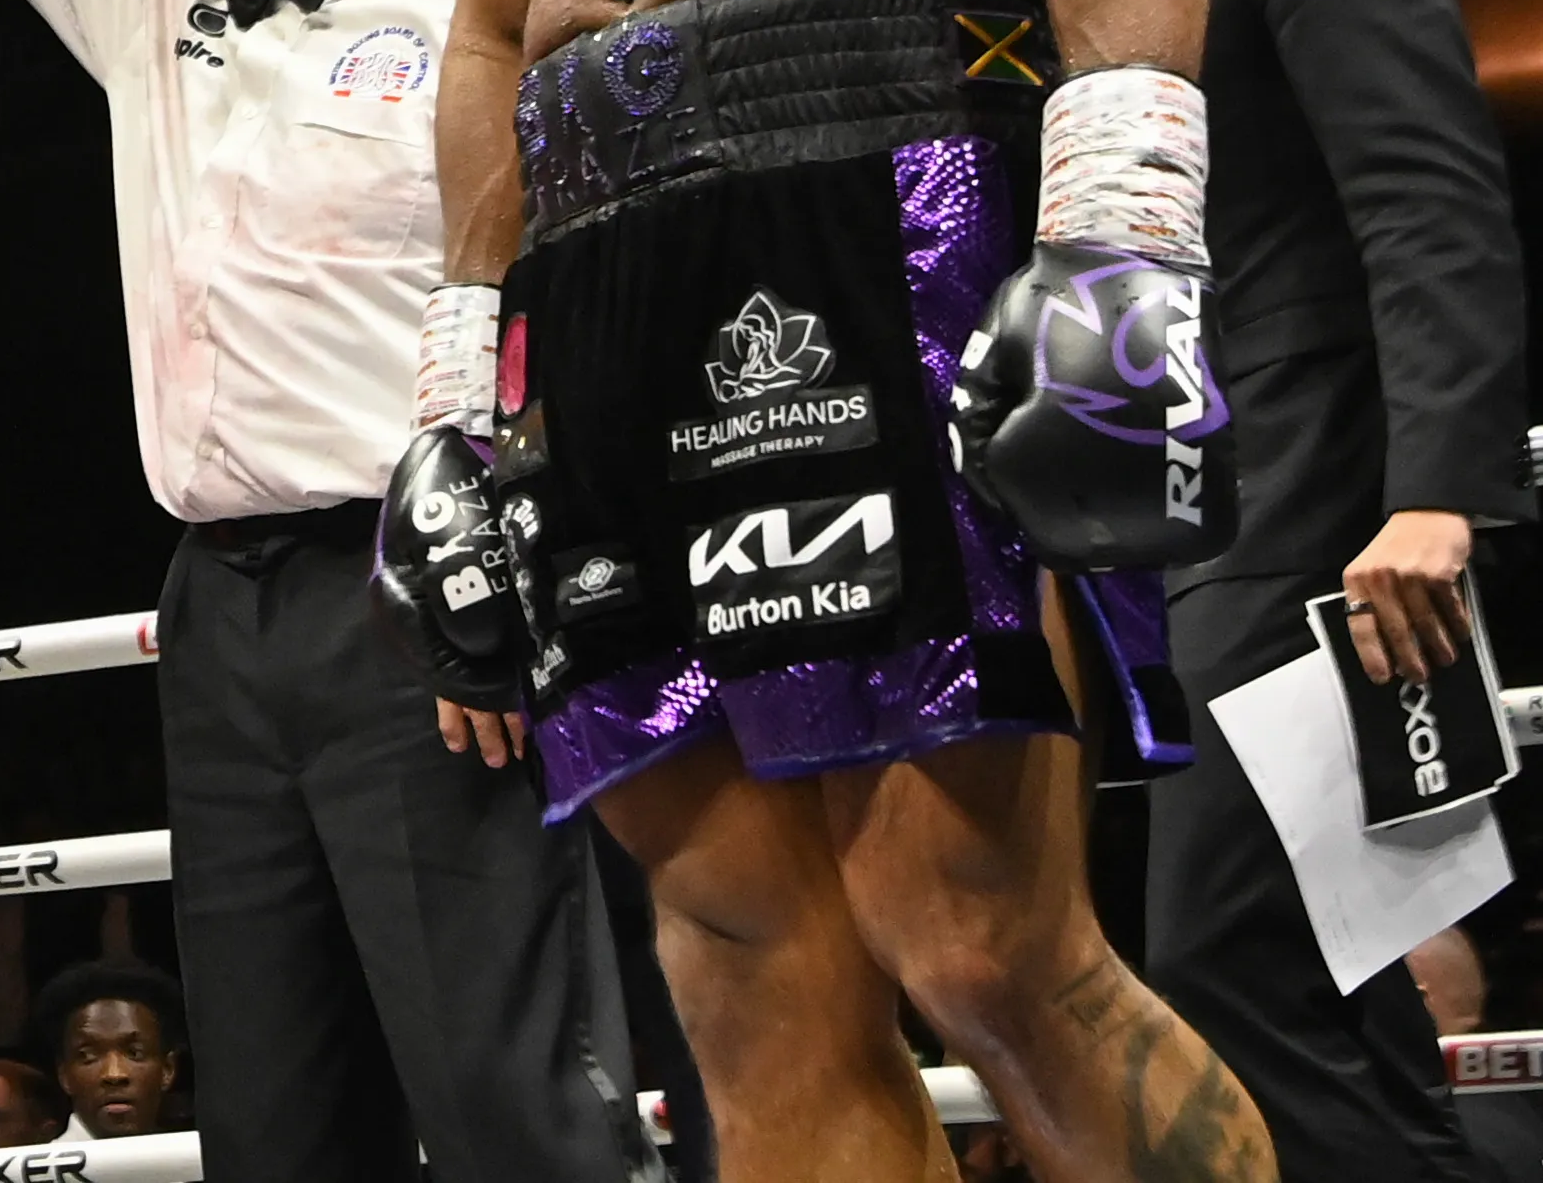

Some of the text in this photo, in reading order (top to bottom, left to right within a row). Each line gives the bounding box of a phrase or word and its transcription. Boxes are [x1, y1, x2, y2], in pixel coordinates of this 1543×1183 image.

[670, 394, 868, 453] HEALING HANDS
[1166, 276, 1204, 528] RIVAL
[759, 434, 826, 455] THERAPY
[707, 580, 872, 636] Burton Kia
